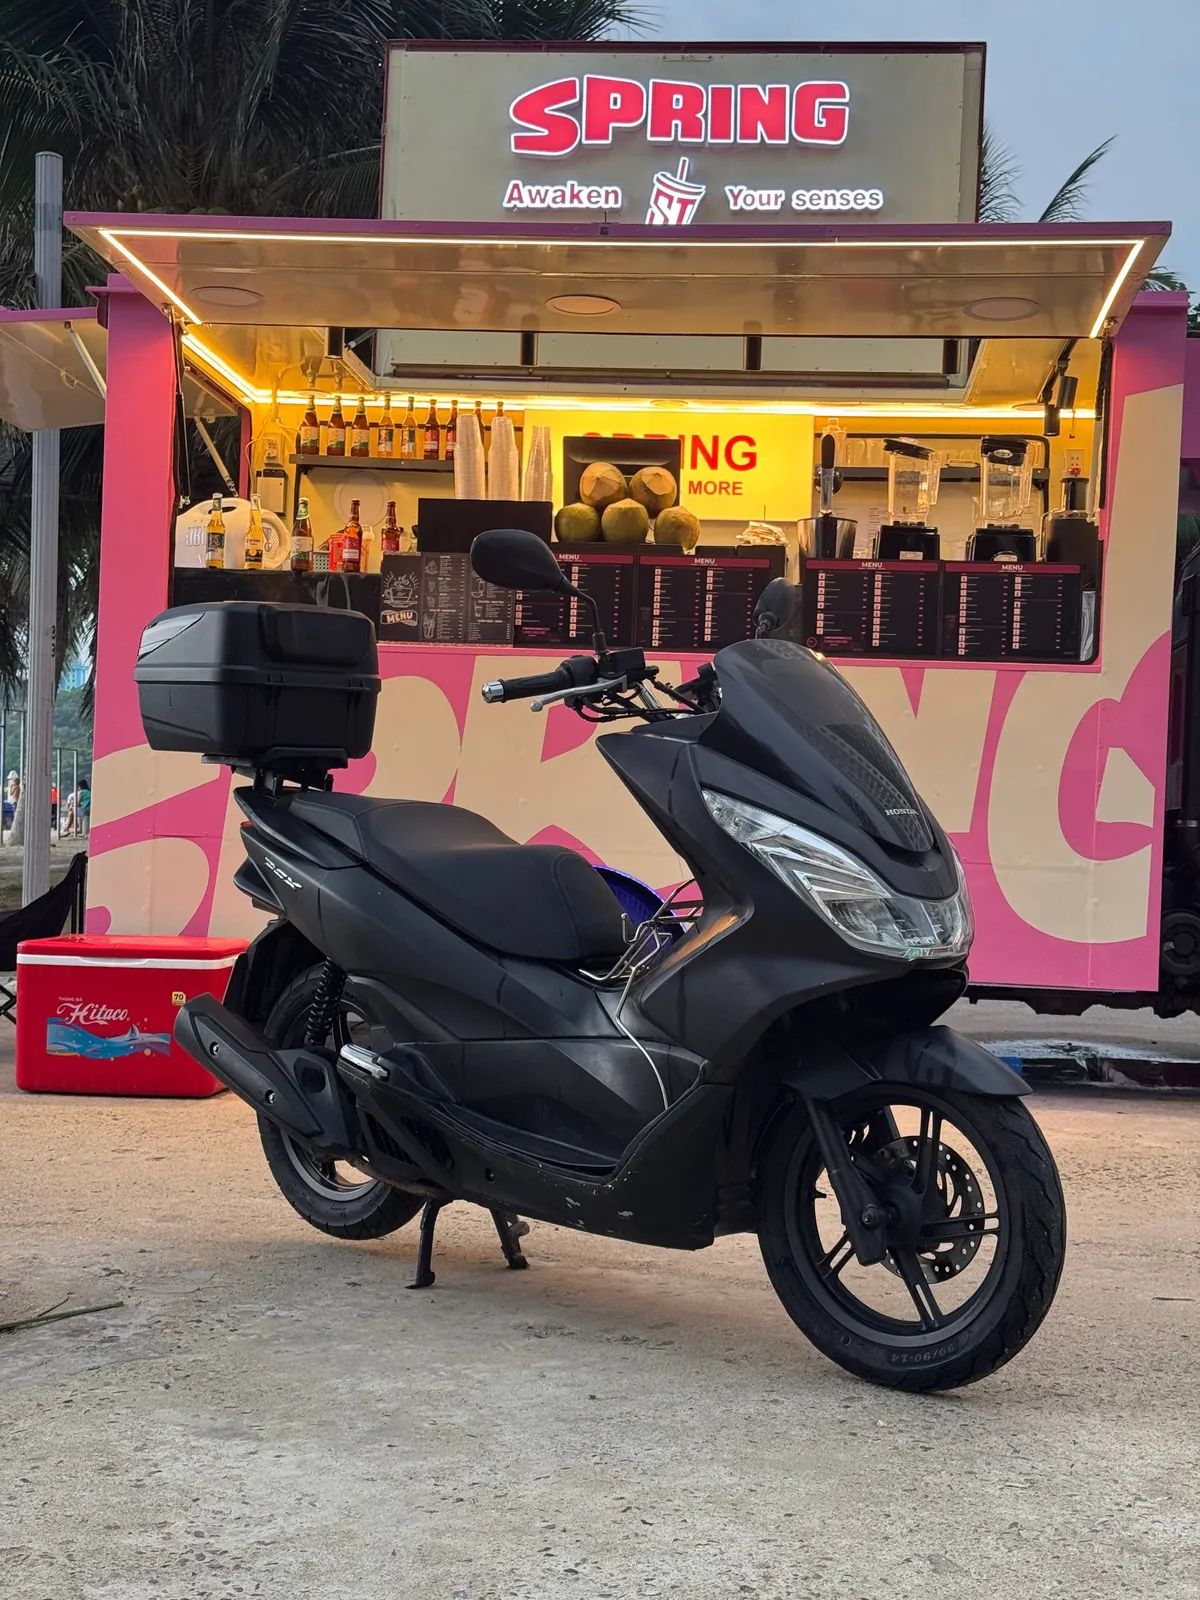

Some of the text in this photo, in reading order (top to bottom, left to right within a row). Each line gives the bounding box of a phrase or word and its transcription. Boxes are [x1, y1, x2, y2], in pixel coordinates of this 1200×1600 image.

[509, 75, 850, 156] SPRING
[504, 180, 883, 210] Awaken Your senses
[582, 432, 757, 472] ING
[688, 480, 743, 496] MORE
[386, 611, 413, 624] MENU
[884, 808, 920, 816] HONDA
[173, 993, 184, 1001] 70
[56, 1002, 128, 1025] Hitaco
